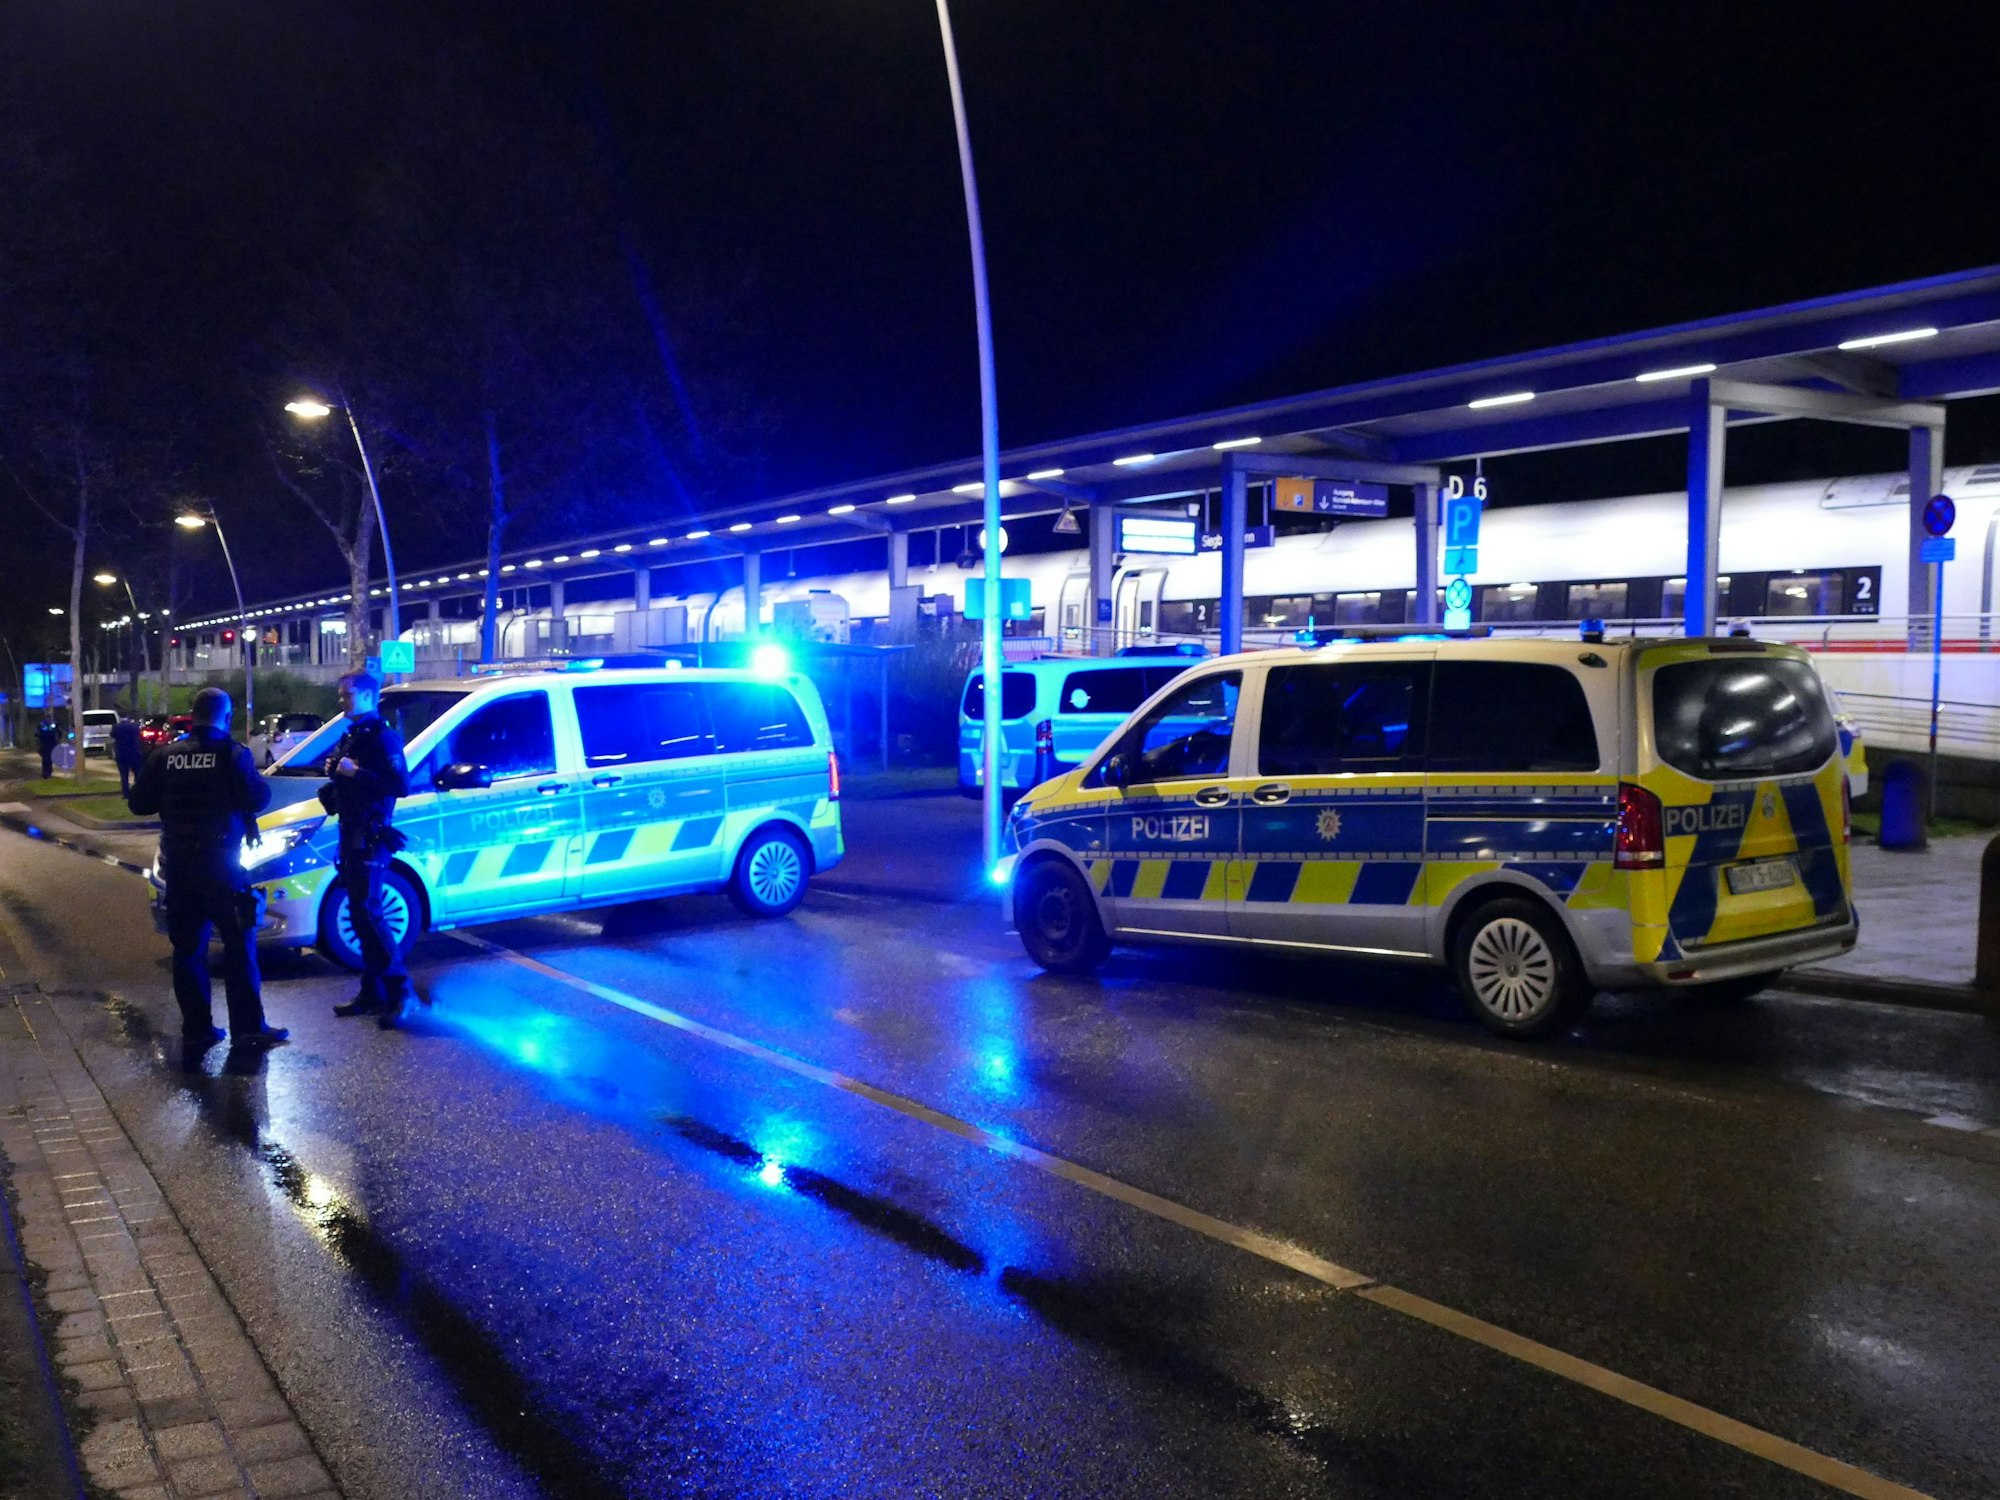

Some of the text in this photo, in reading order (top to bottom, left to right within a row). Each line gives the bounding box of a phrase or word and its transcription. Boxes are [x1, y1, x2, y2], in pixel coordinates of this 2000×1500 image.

[1449, 475, 1487, 501] D 6
[1453, 505, 1472, 541] P
[1857, 576, 1872, 599] 2
[1198, 605, 1206, 620] 2
[166, 753, 216, 770] POLIZEI
[470, 805, 555, 832] POLIZEI
[1131, 815, 1210, 841] POLIZEI
[1665, 804, 1745, 833] POLIZEI
